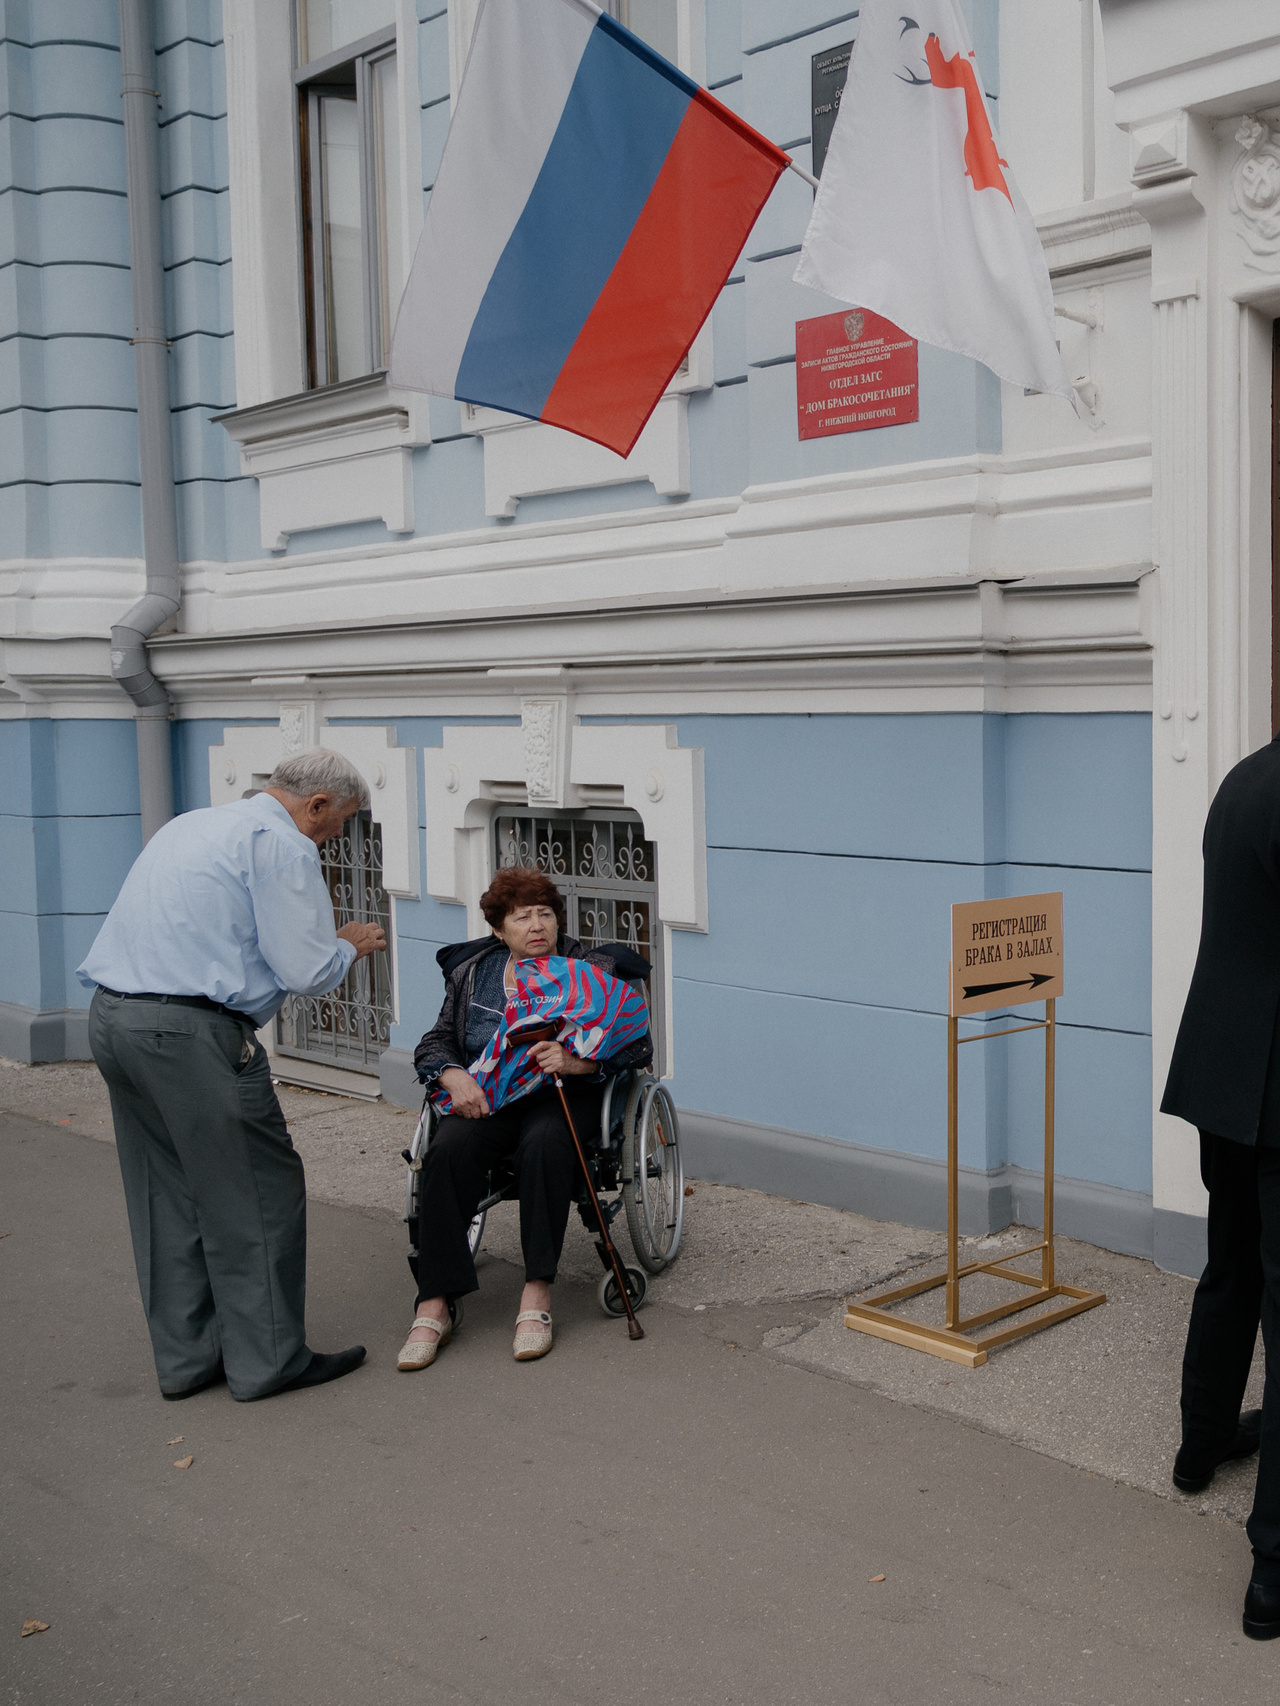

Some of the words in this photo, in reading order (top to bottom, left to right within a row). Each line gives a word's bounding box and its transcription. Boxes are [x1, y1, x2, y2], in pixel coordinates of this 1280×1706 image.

[801, 358, 821, 368] ЗАПИСИ
[822, 356, 838, 364] АКТОВ
[839, 348, 879, 360] ГРАЖДАНСКОГО
[881, 340, 913, 352] СОСТОЯНИЯ
[826, 345, 849, 355] ГЛАВНОЕ
[851, 338, 884, 350] УПРАВЛЕНИЕ
[821, 358, 866, 372] НИЖЕГОРОДСКОЙ
[867, 353, 891, 363] ОБЛАСТИ
[830, 375, 858, 389] ОТДЕЛ
[860, 371, 883, 384] ЗАГС
[818, 419, 824, 427] Г.
[825, 413, 856, 426] НИЖНИЙ
[858, 407, 896, 420] НОВГОРОД
[972, 914, 1047, 941] РЕГИСТРАЦИЯ
[965, 945, 1002, 966] БРАКА
[1007, 943, 1013, 960] В
[1017, 937, 1053, 958] ЗАЛАХ
